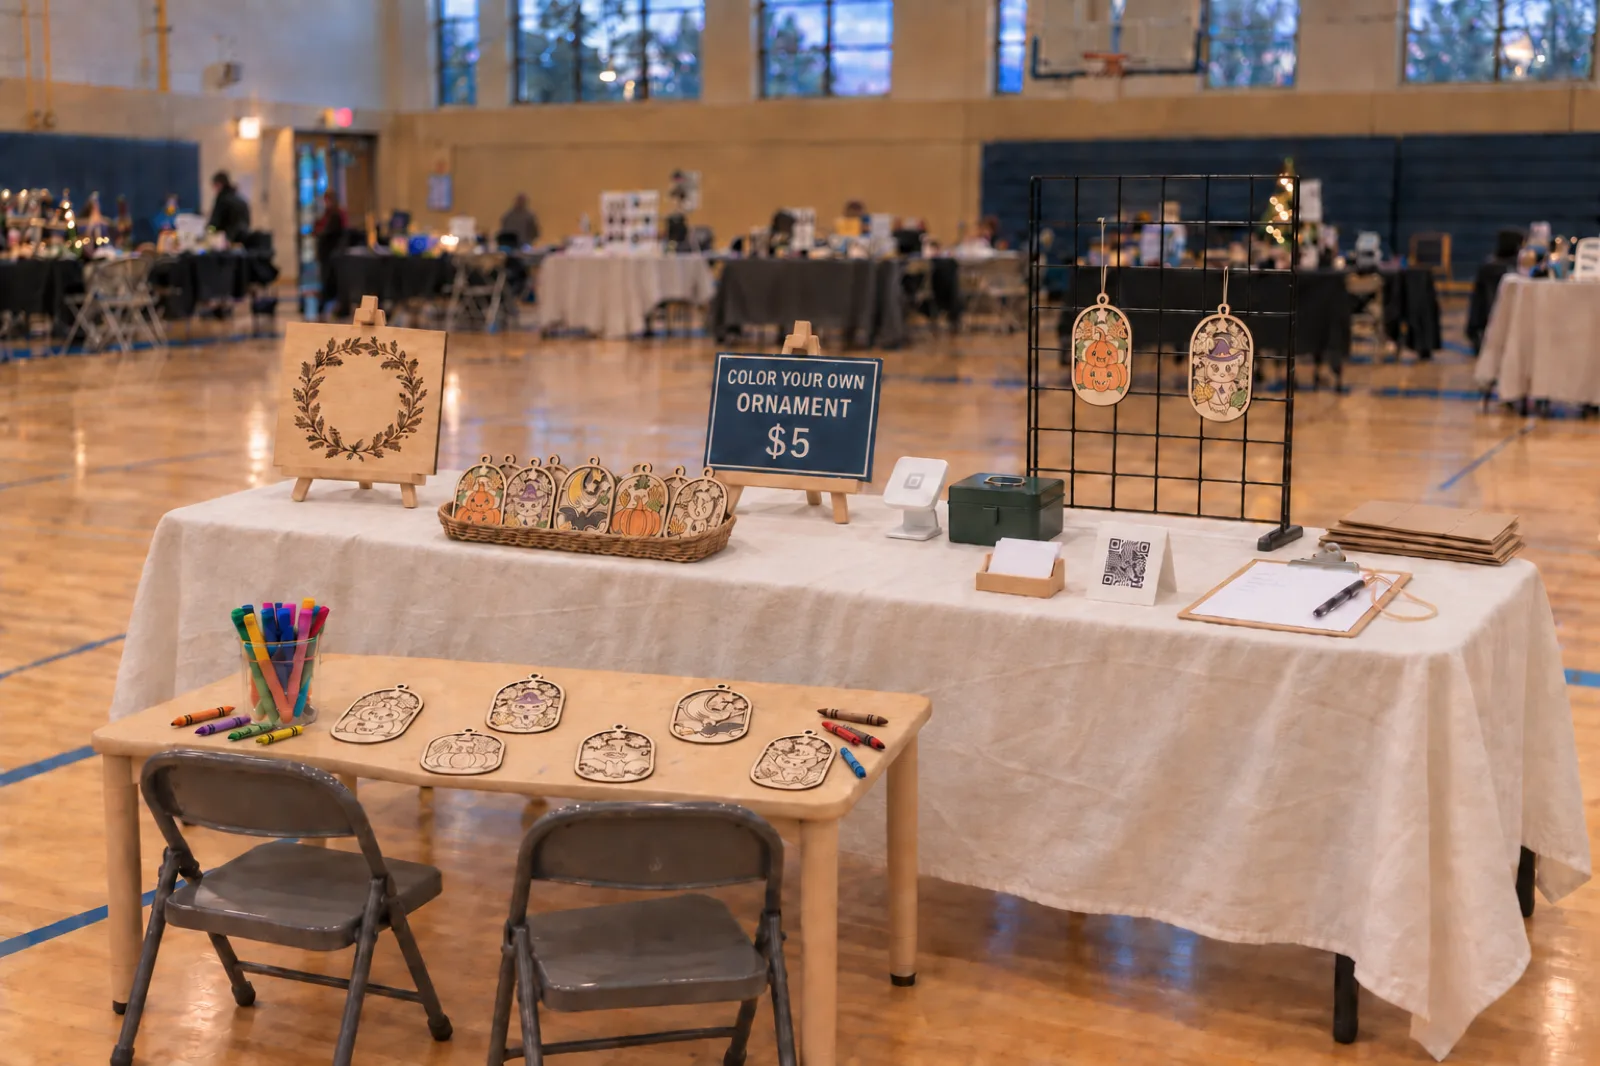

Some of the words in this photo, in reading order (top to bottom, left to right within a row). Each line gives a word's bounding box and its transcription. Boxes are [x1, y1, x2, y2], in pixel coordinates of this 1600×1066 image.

[727, 369, 777, 386] COLOR
[781, 371, 823, 388] YOUR
[827, 373, 865, 390] OWN
[737, 392, 852, 418] ORNAMENT
[765, 423, 810, 459] $5
